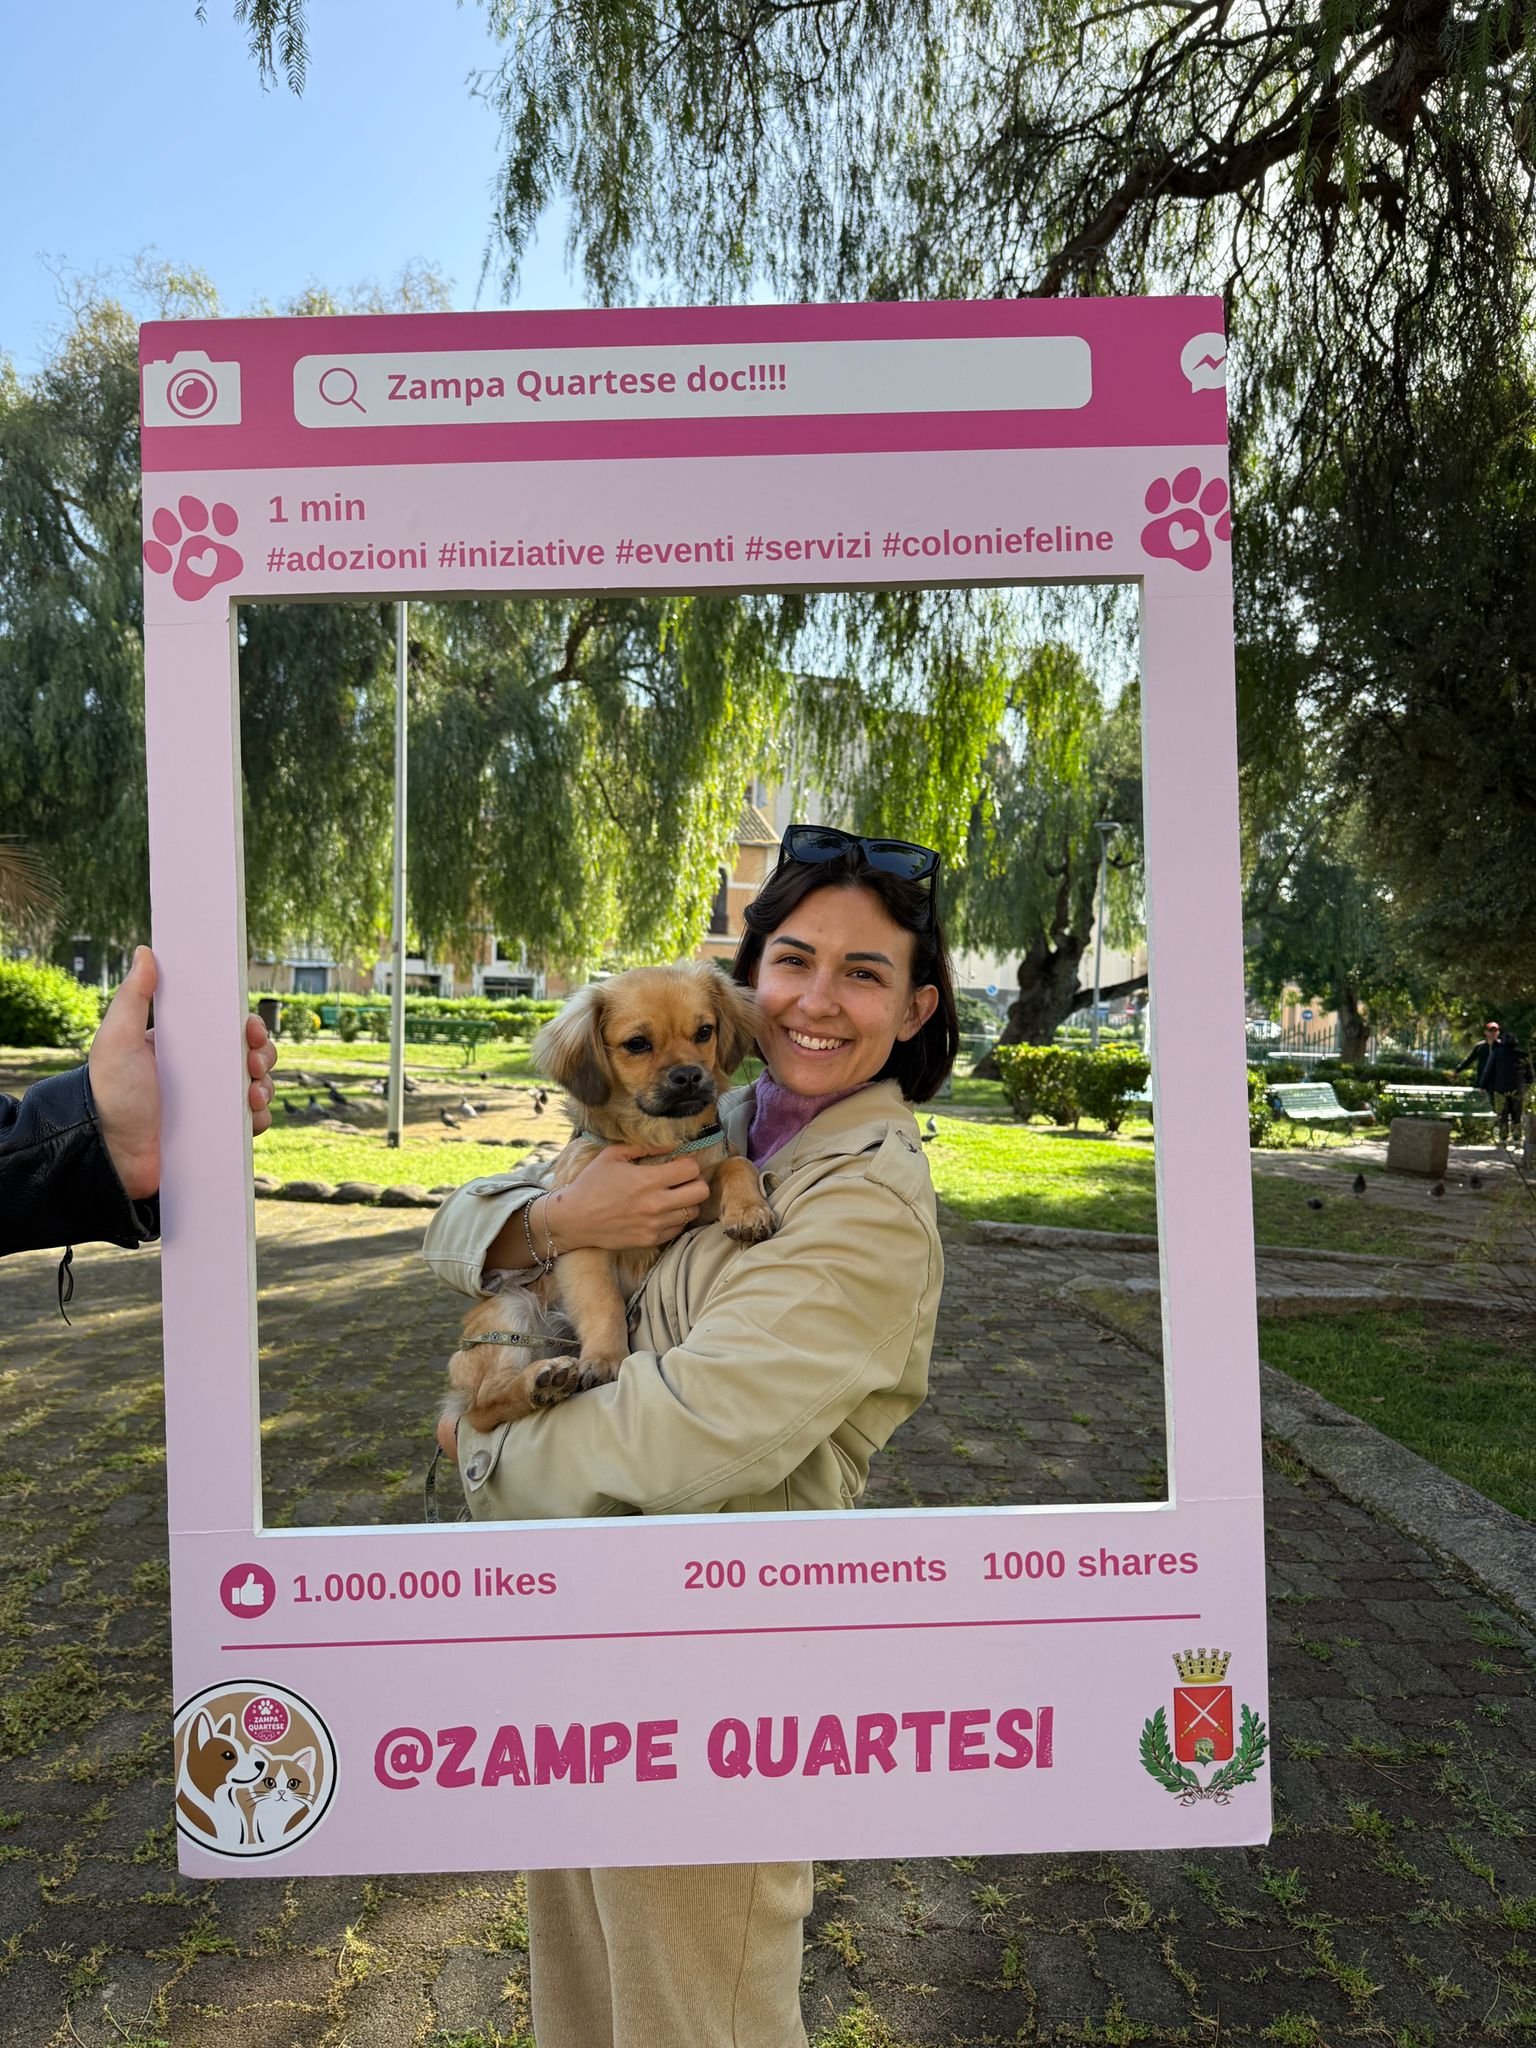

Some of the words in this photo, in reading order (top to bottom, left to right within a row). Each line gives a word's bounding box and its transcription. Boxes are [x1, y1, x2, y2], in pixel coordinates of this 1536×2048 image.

[387, 374, 505, 406] Zampa
[517, 371, 676, 401] Quartese
[687, 364, 785, 392] doc!!!!
[269, 496, 288, 523] 1
[301, 493, 366, 521] min
[267, 543, 427, 572] #adozioni
[439, 539, 604, 568] #iniziative
[616, 535, 734, 565] #eventi
[746, 532, 871, 560] #servizi
[882, 525, 1113, 557] #coloniefeline
[684, 1559, 745, 1589] 200
[758, 1556, 947, 1587] comments
[983, 1551, 1065, 1581] 1000
[1078, 1548, 1198, 1578] shares
[293, 1570, 462, 1602] 1.000.000
[474, 1567, 557, 1597] likes
[248, 1723, 285, 1732] QUARTESE
[374, 1720, 678, 1790] @ZAMPE
[708, 1707, 1053, 1778] QUARTESI
